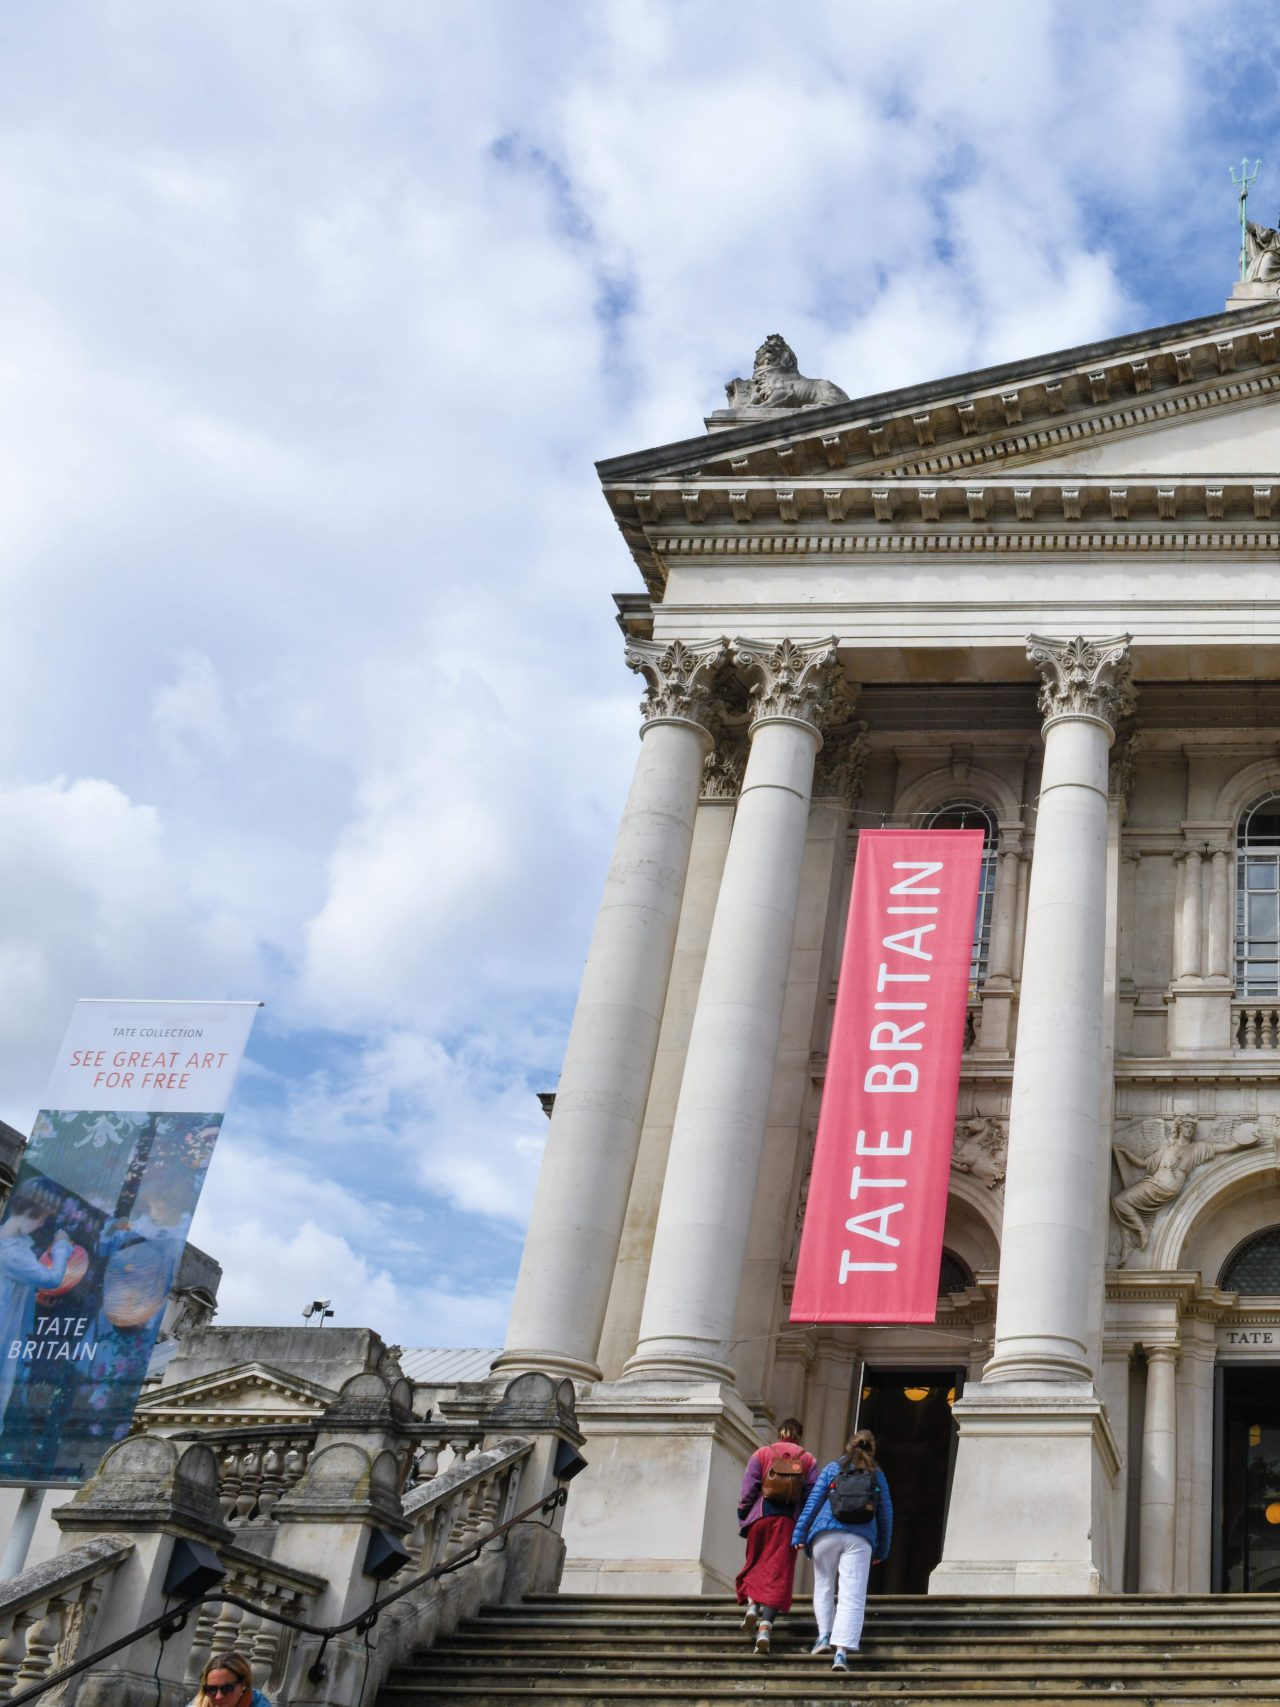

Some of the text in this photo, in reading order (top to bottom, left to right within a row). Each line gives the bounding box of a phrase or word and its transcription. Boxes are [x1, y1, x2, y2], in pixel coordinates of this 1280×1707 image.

[112, 1027, 204, 1038] TATE COLLECTION
[70, 1050, 229, 1069] SEE GREAT ART
[93, 1071, 191, 1089] FOR FREE
[838, 861, 943, 1285] TATE BRITAIN
[36, 1316, 88, 1337] TATE
[1226, 1332, 1273, 1344] TATE
[7, 1340, 98, 1360] BRITAIN
